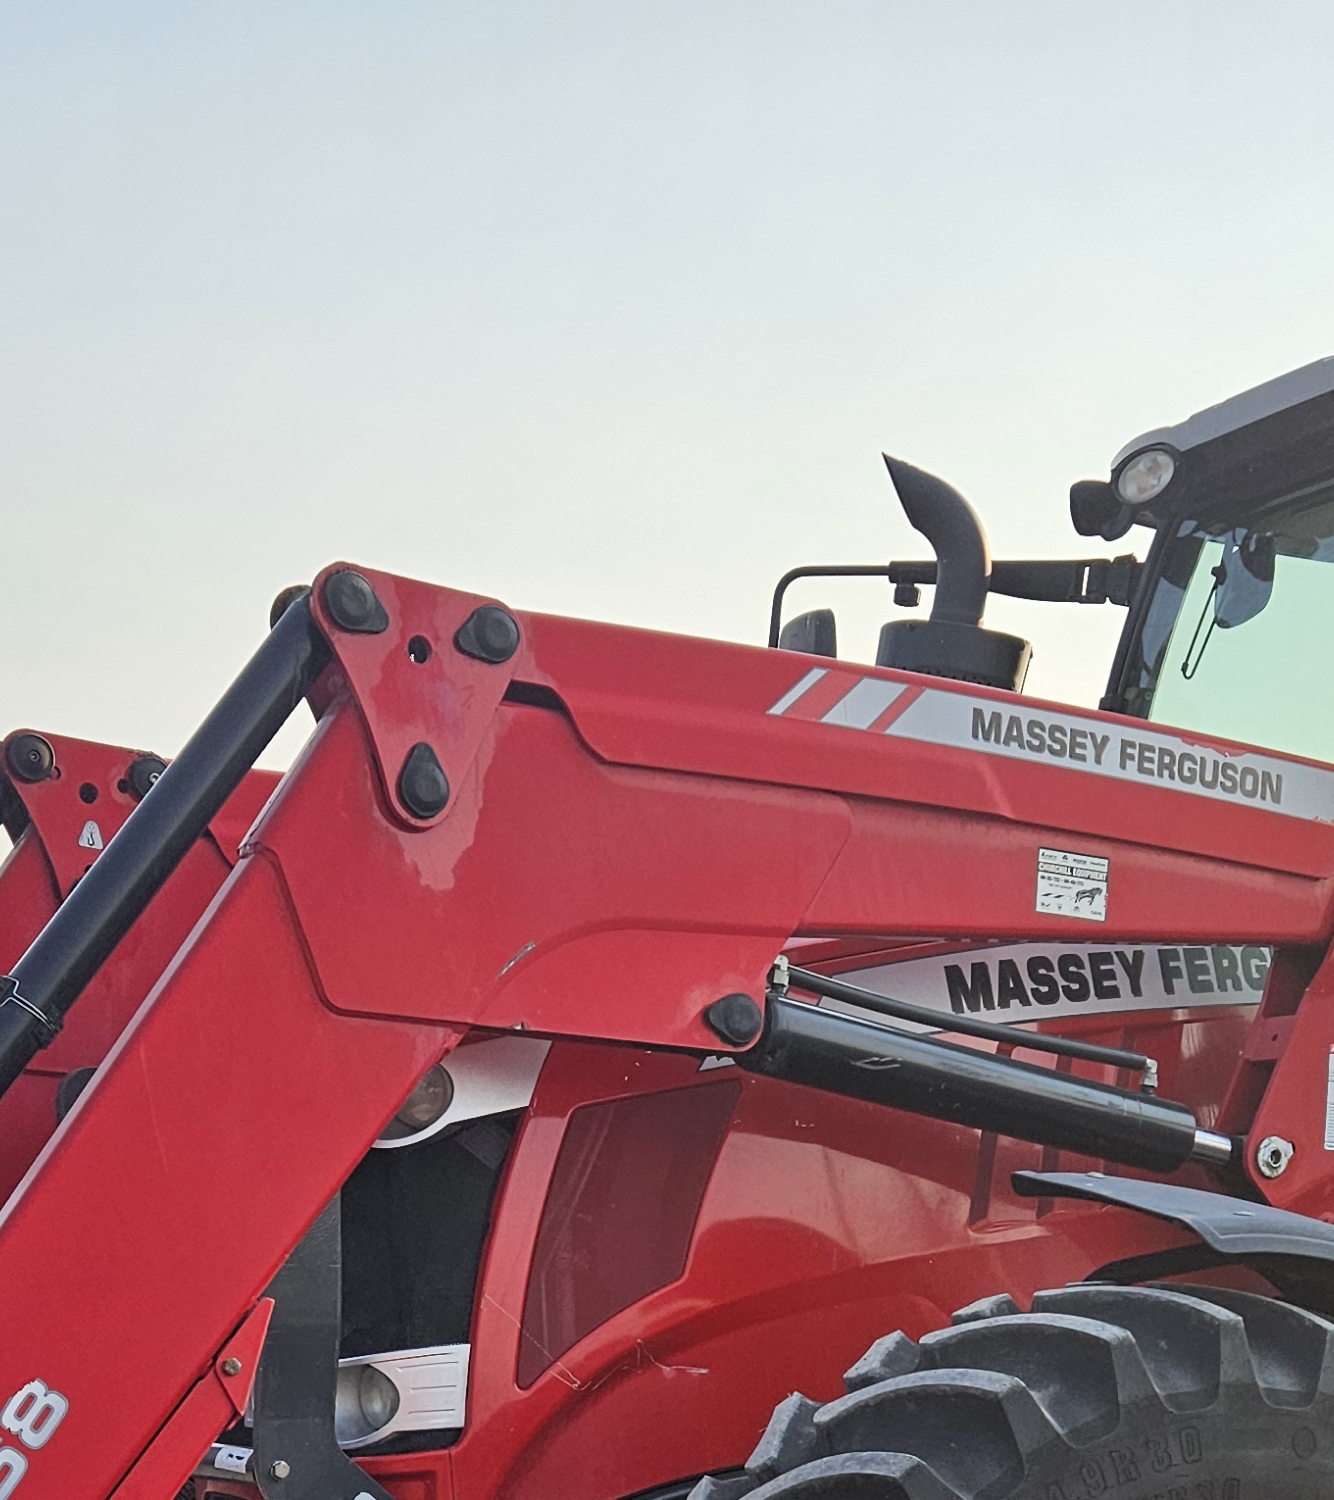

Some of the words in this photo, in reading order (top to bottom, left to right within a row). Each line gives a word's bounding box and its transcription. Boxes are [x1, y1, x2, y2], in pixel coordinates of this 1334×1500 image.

[971, 706, 1110, 766] MASSEY
[1118, 738, 1283, 805] FERGUSON
[944, 950, 1146, 1015] MASSEY
